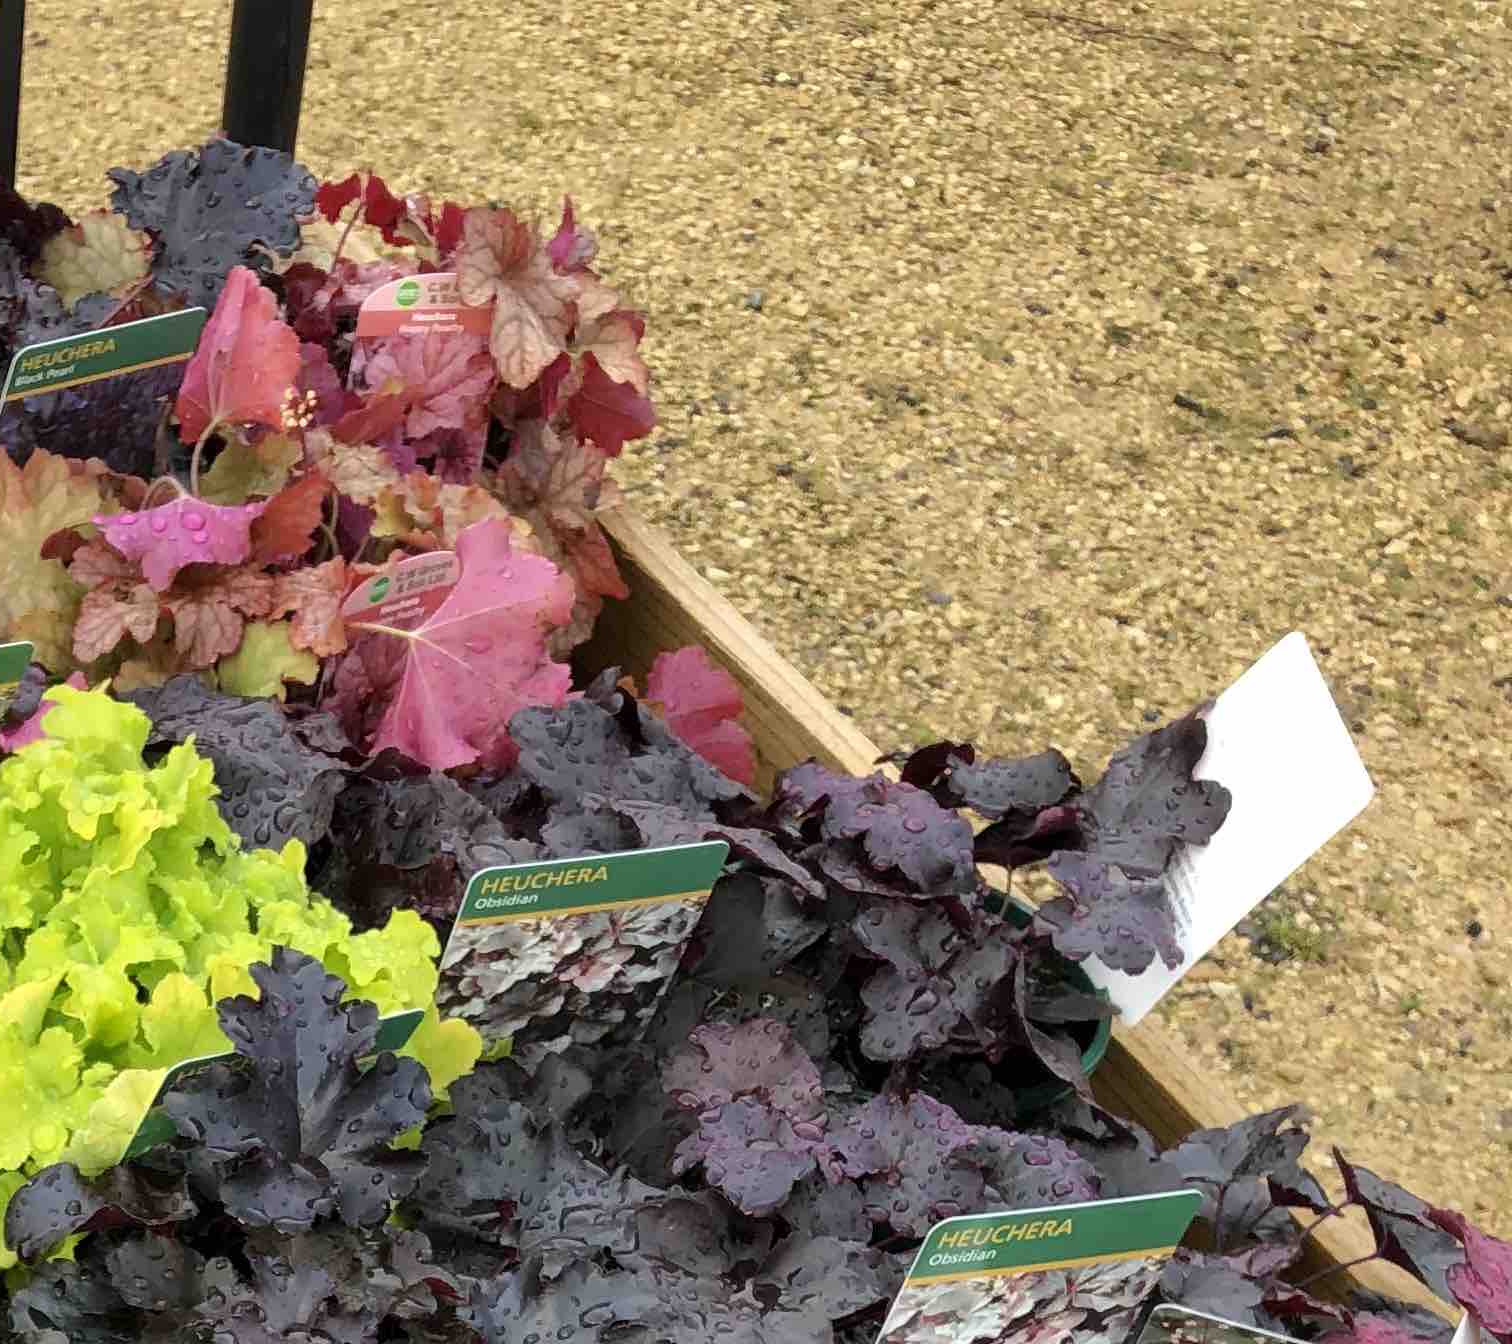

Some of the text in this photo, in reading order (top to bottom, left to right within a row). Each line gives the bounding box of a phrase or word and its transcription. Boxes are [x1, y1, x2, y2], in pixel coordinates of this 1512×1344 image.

[20, 337, 116, 371] HEUCHERA
[480, 864, 609, 896] HEUCHERA
[473, 893, 540, 911] Obsidian
[937, 1218, 1074, 1249] HEUCHERA
[928, 1247, 998, 1267] Obsidian
